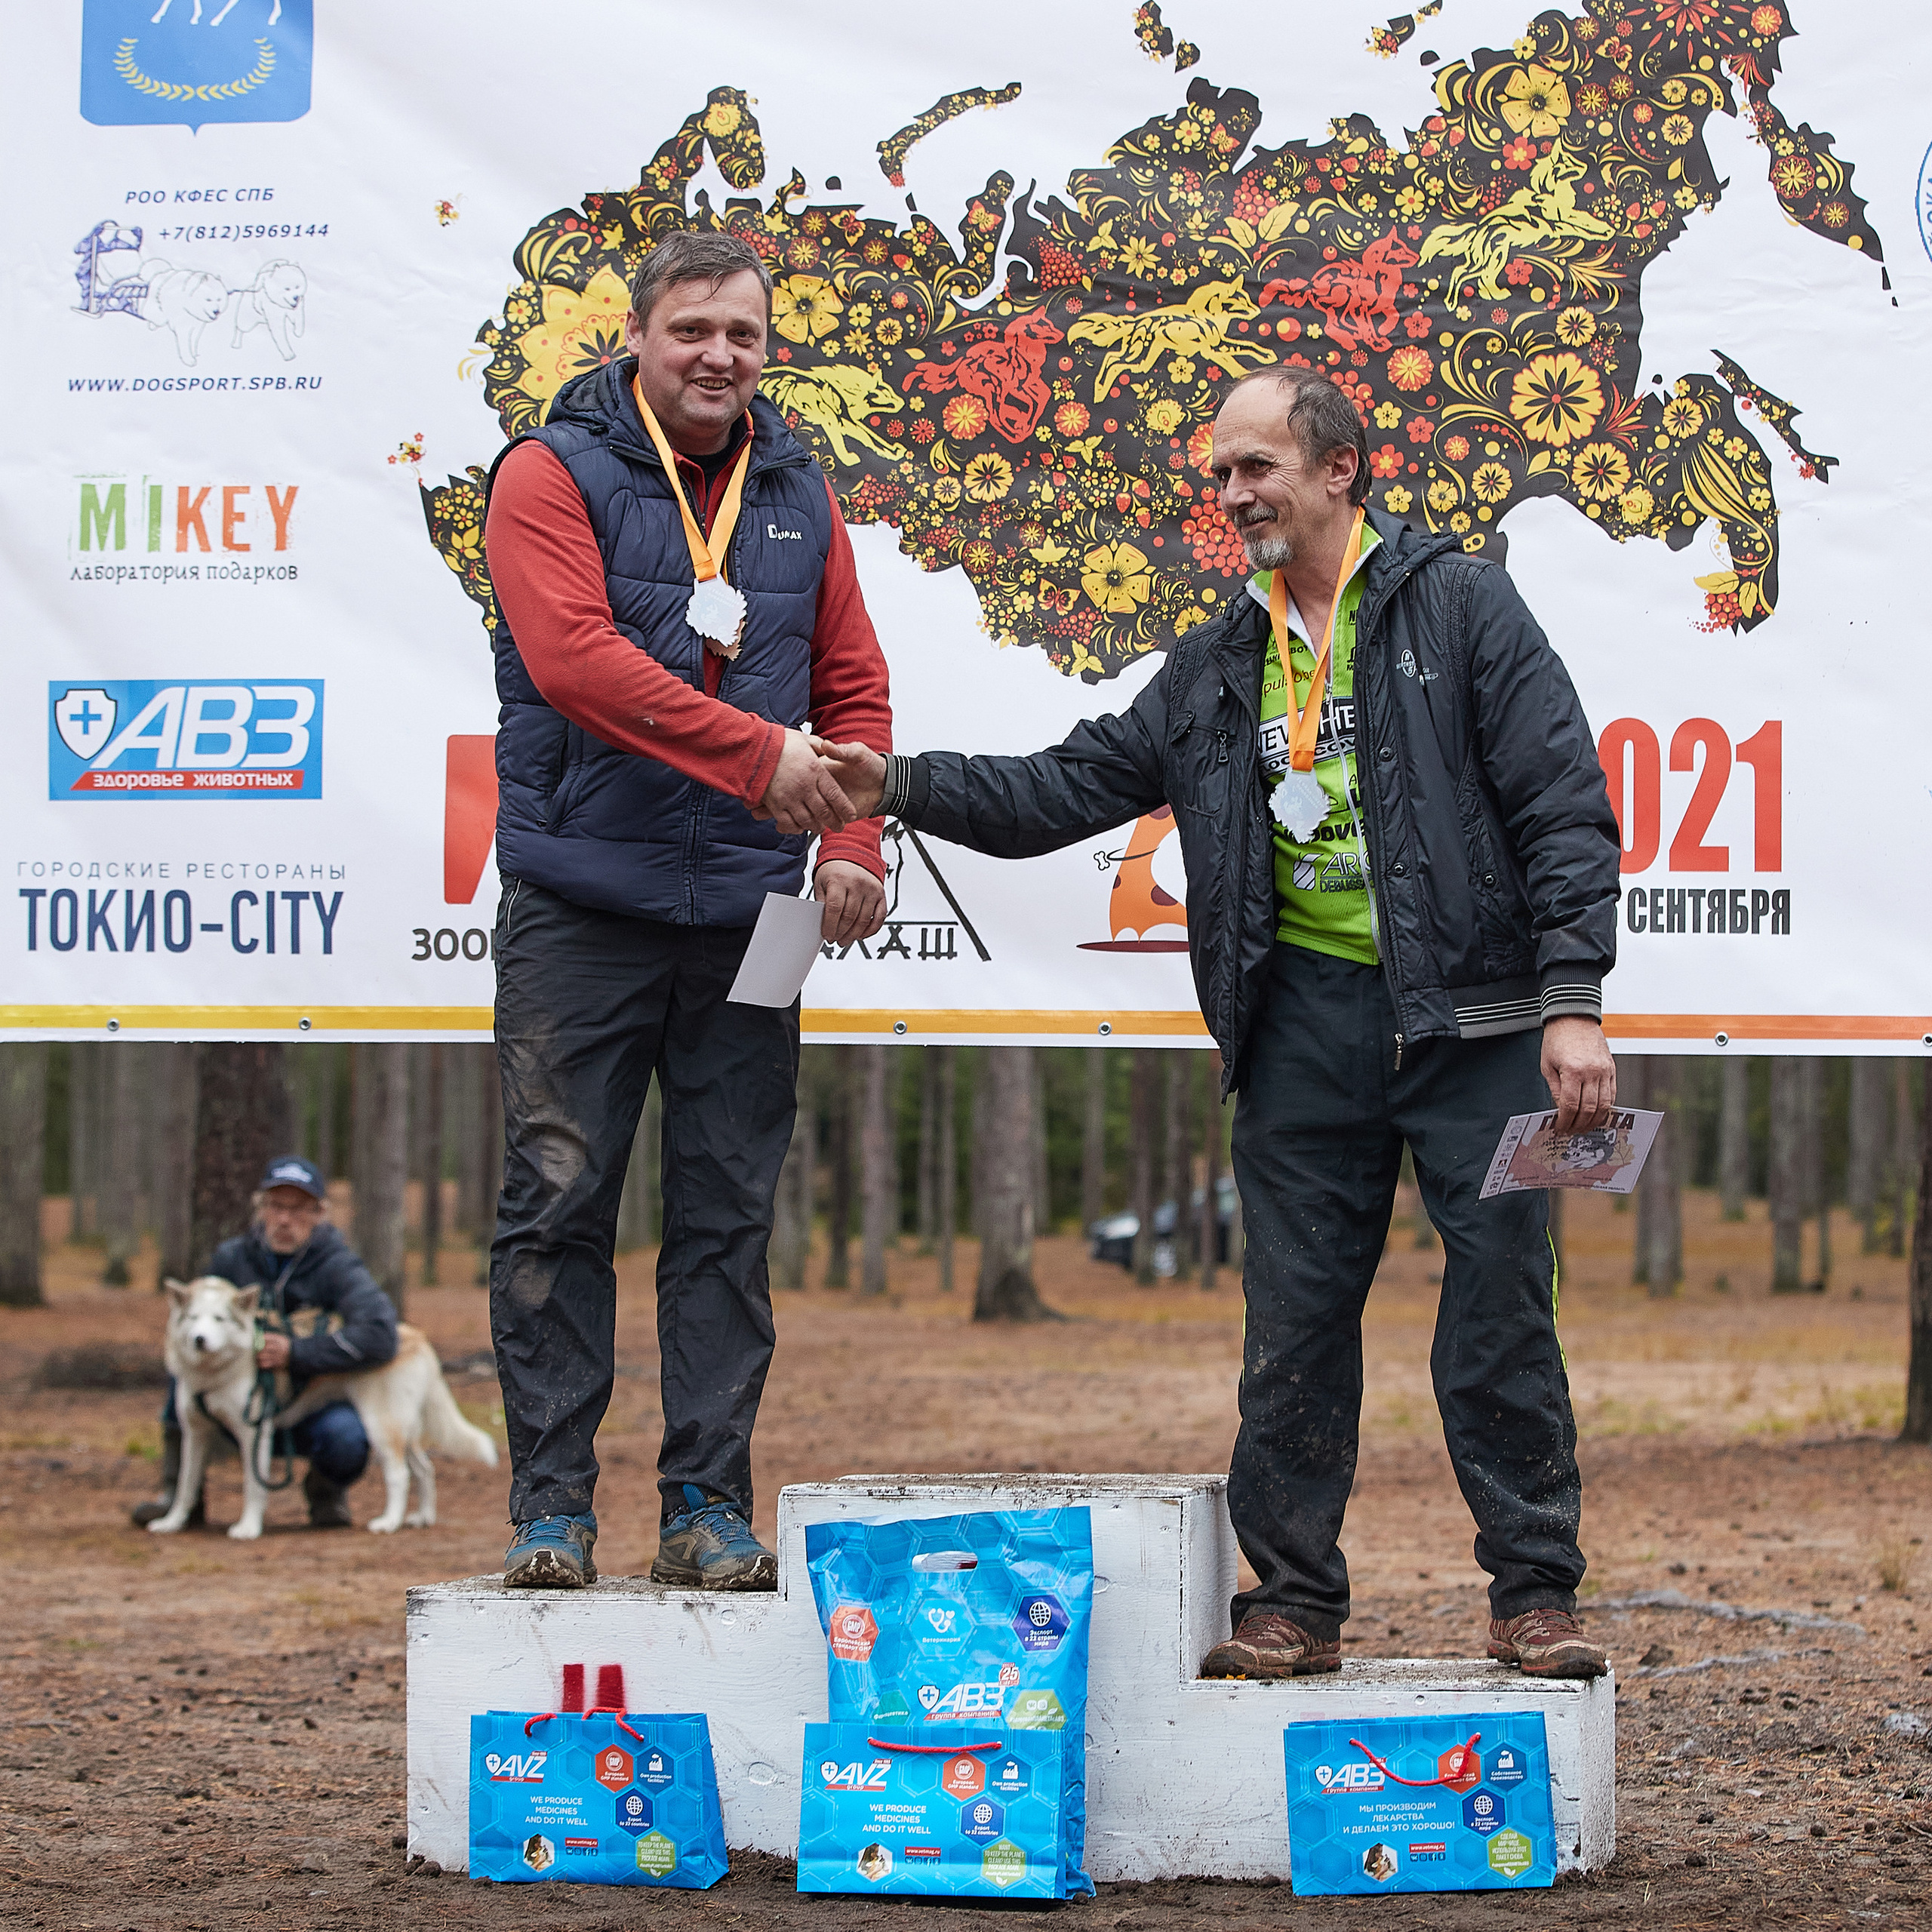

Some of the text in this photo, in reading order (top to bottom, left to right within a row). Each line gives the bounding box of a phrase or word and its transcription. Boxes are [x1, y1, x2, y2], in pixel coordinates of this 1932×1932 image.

[125, 188, 275, 204] РОО КФЕС СПБ
[159, 224, 329, 242] +7(812)5969144
[68, 376, 322, 392] WWW.DOGSPORT.SPB.RU
[79, 484, 299, 552] MIKEY
[70, 561, 298, 584] лаборатория подарков
[89, 686, 315, 769] АВЗ
[94, 773, 293, 790] здоровье животных
[17, 861, 346, 880] ГОРОДСКИЕ РЕСТОРАНЫ
[1627, 887, 1791, 935] СЕНТЯБРЯ
[1001, 1666, 1019, 1681] 25
[494, 1755, 547, 1779] AVZ
[830, 1762, 891, 1786] AVZ
[544, 1797, 583, 1805] PRODUCE
[869, 1804, 927, 1814] WE PRODUCE
[1359, 1802, 1436, 1813] МЫ ПРОИЗВОДИМ
[535, 1806, 578, 1816] MEDICINES
[874, 1814, 920, 1823] MEDICINES
[1372, 1813, 1424, 1823] ЛЕКАРСТВА
[525, 1816, 542, 1824] AND
[557, 1817, 566, 1825] IT
[1352, 1823, 1389, 1835] ДЕЛАЕМ
[1392, 1823, 1409, 1832] ЭТО
[1411, 1821, 1455, 1831] ХОРОШО!
[862, 1824, 931, 1835] AND DO IT WELL
